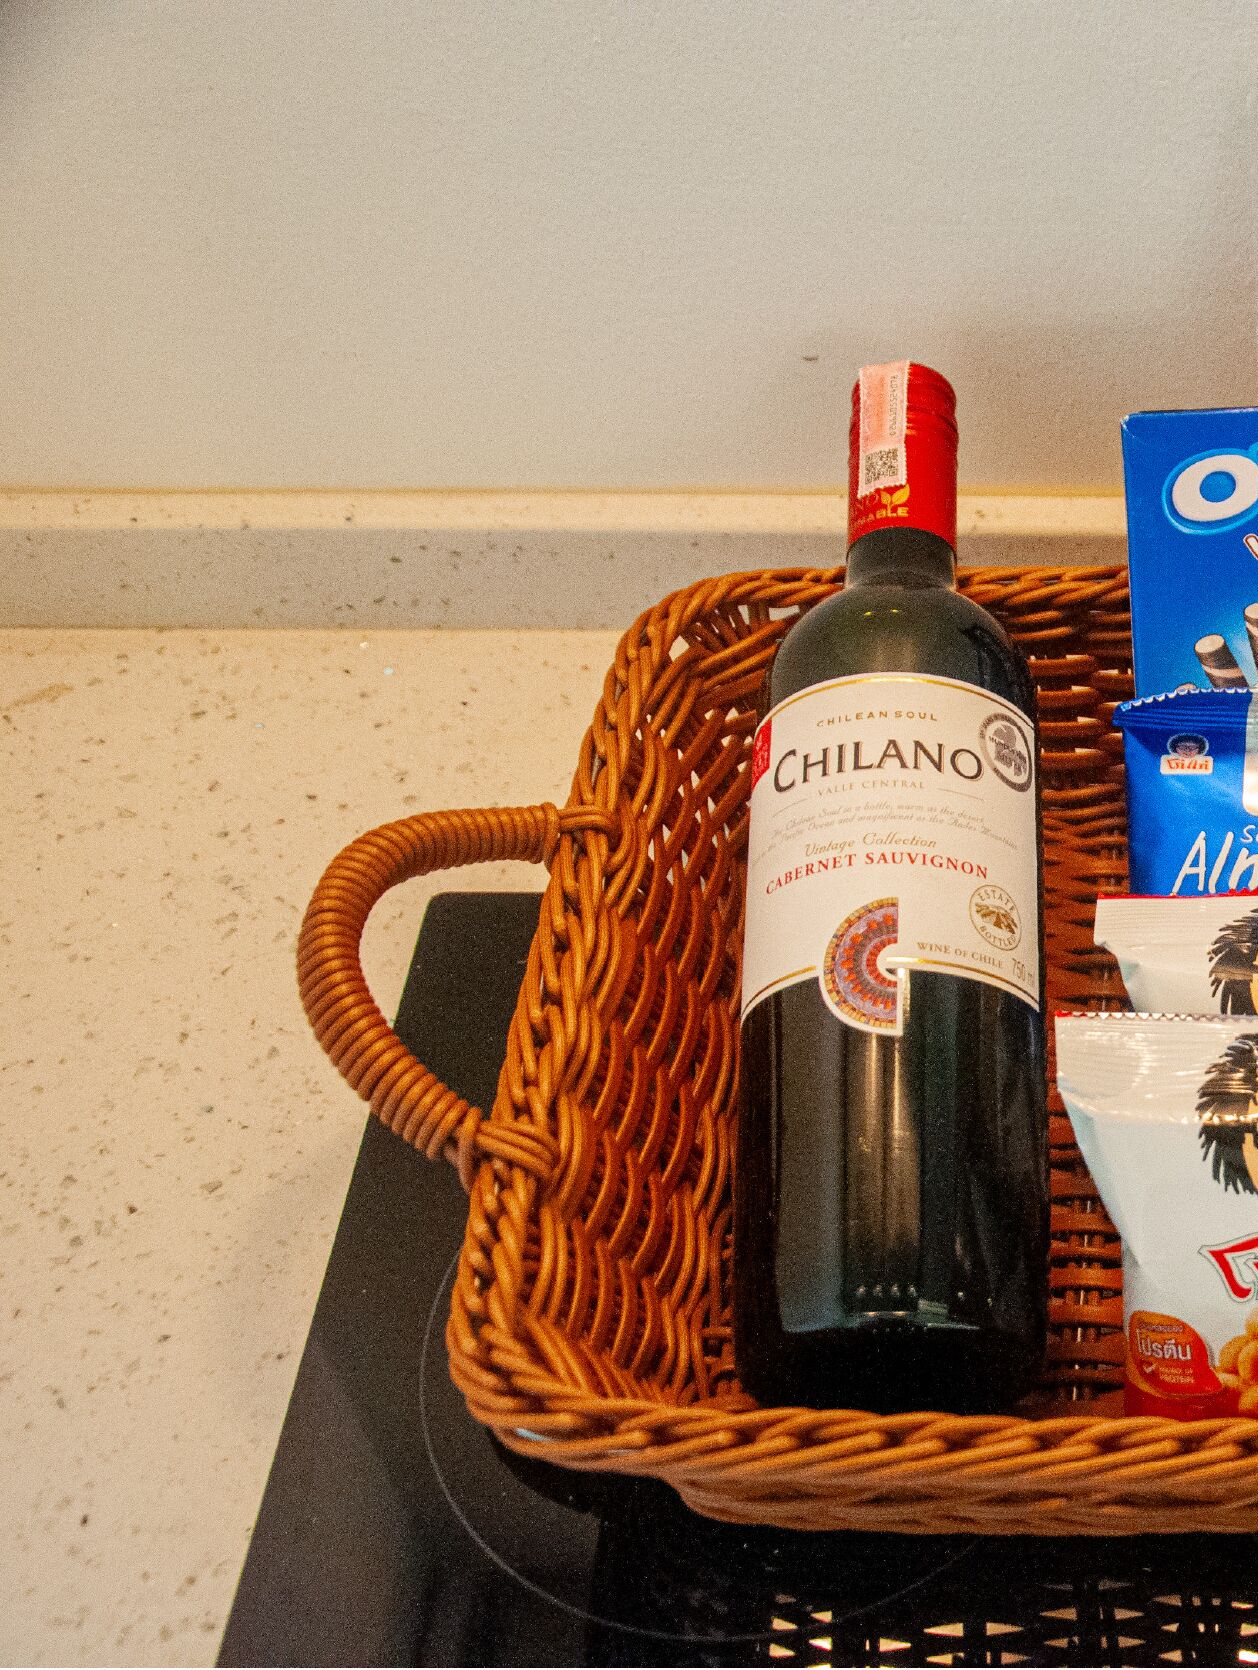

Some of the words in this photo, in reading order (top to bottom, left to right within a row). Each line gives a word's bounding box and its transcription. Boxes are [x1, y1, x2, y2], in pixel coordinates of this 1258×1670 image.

[817, 709, 889, 727] CHILEAN
[894, 709, 939, 722] SOUL
[773, 739, 984, 794] CHILANO
[817, 782, 857, 797] VALLE
[861, 779, 926, 792] CENTRAL
[805, 840, 855, 858] Vintage
[863, 832, 937, 848] Collection
[765, 852, 857, 895] CABERNET
[865, 851, 989, 880] SAUVIGNON
[977, 889, 1016, 912] ESTATE
[979, 925, 1017, 947] BOTTLED
[917, 942, 951, 954] WINE
[954, 948, 968, 958] OF
[971, 951, 1004, 968] CHILE
[1136, 1328, 1192, 1361] โปรตีน
